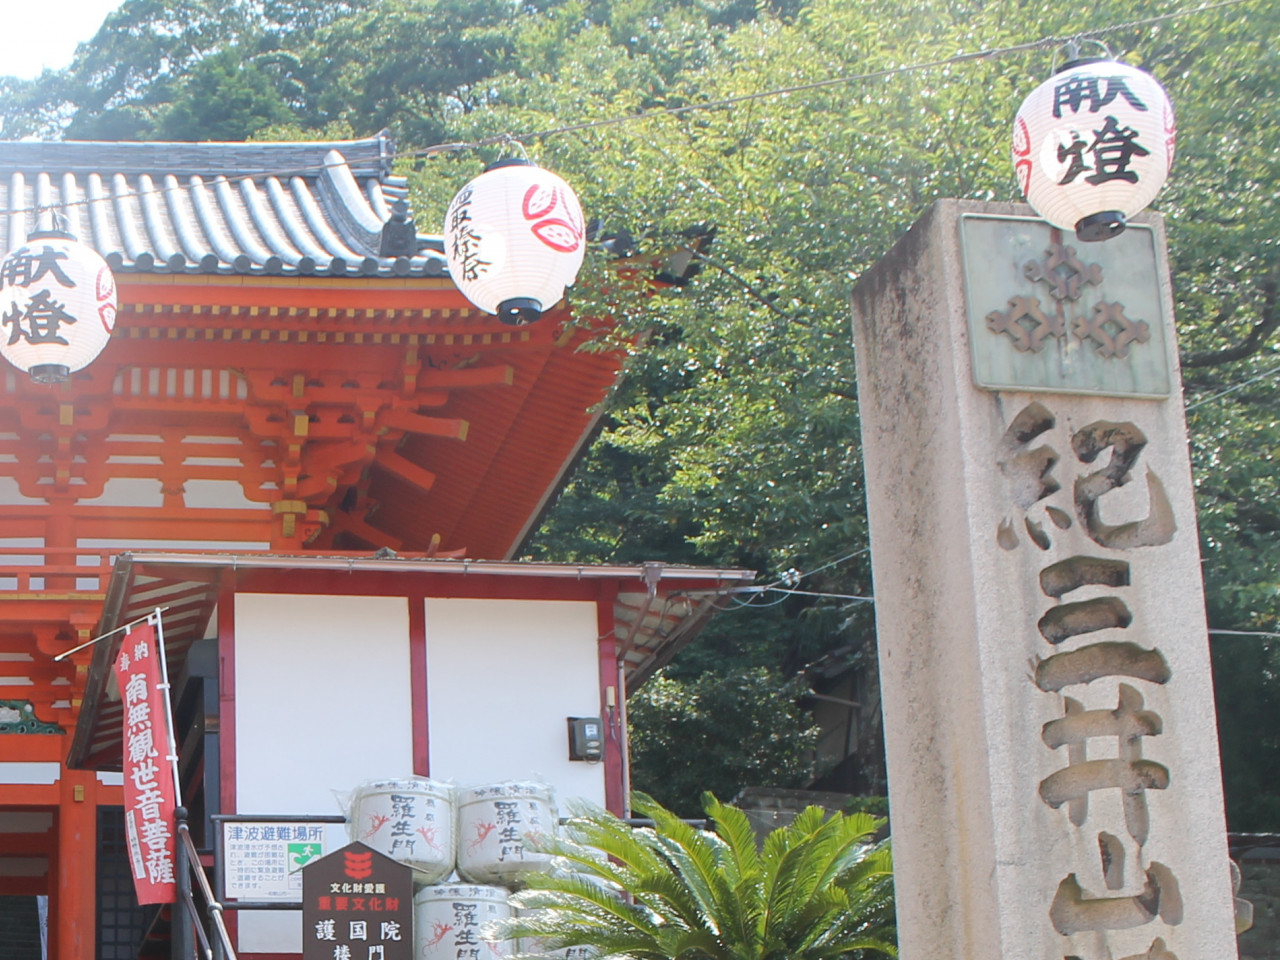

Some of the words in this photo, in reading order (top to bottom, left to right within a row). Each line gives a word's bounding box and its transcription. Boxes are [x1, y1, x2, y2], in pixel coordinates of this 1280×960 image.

[124, 673, 177, 885] 南無観世音菩薩
[228, 826, 323, 841] 津波避難場所
[388, 795, 416, 855] 羅生門
[494, 802, 524, 862] 羅生門
[330, 883, 386, 894] 文化財愛護
[318, 896, 399, 911] 重要文化財
[315, 919, 402, 940] 護国院
